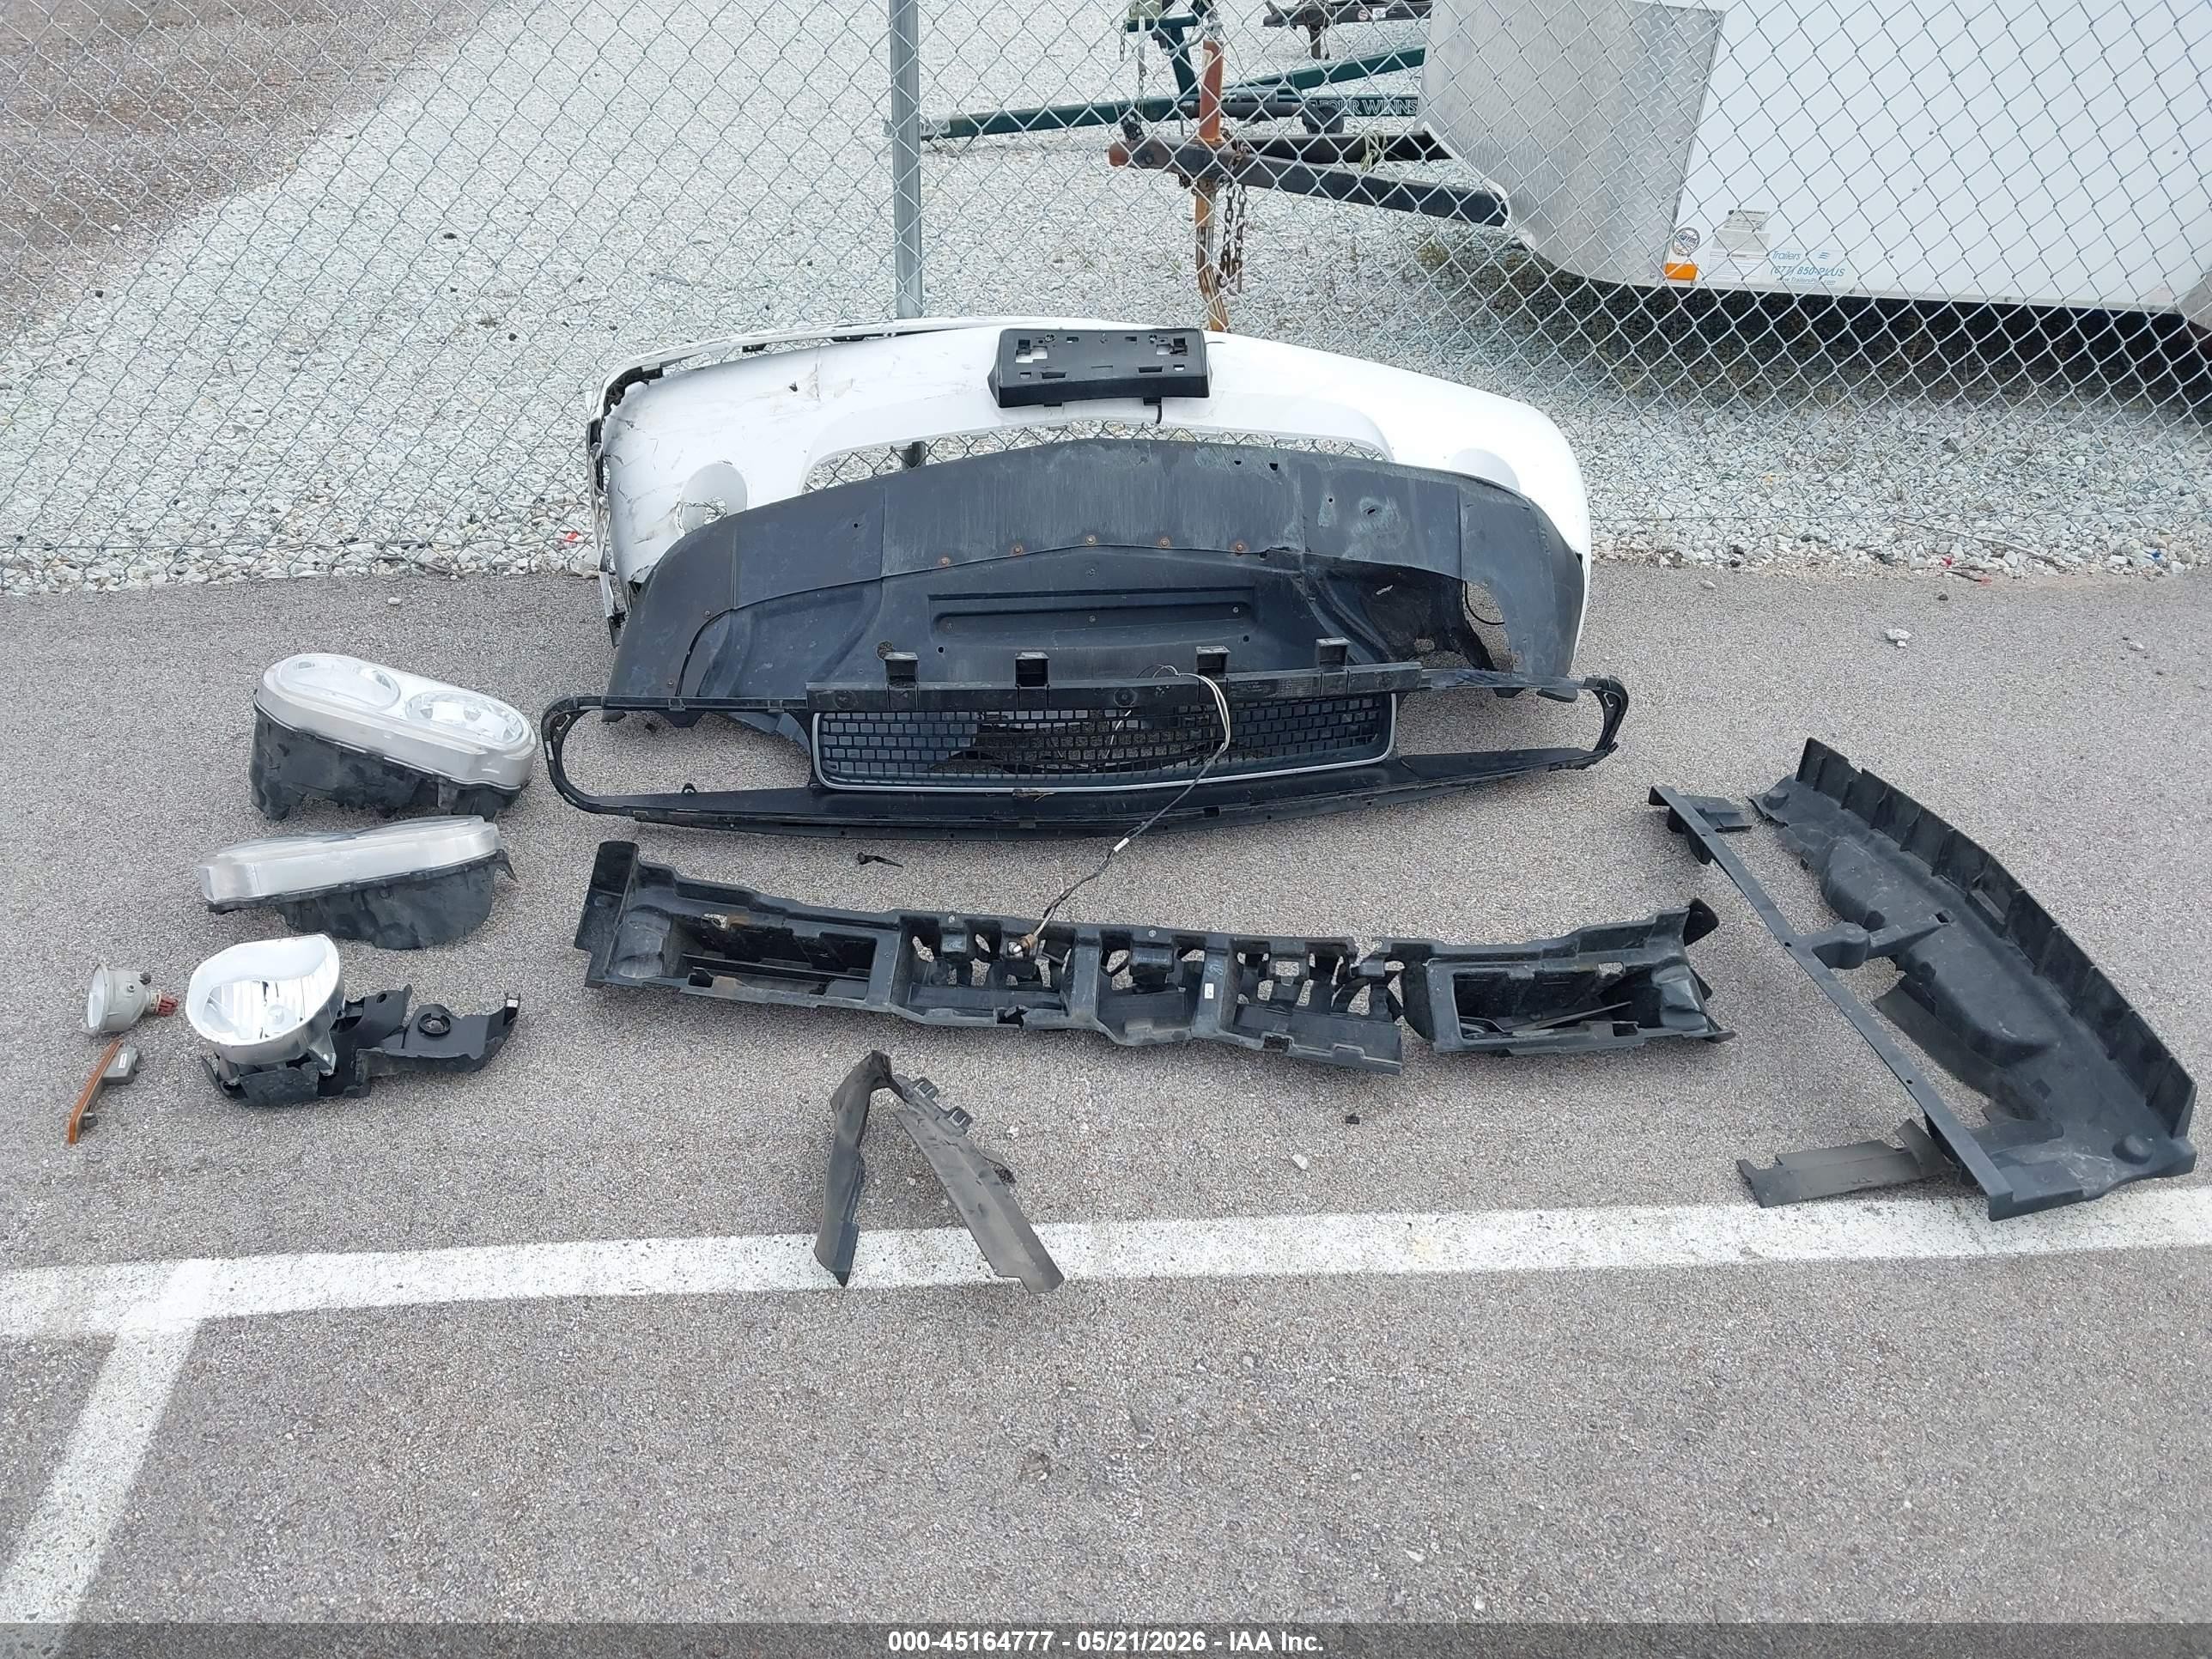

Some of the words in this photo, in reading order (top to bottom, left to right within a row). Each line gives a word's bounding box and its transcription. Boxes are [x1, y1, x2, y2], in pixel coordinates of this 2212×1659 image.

[1362, 100, 1417, 114] WINNS
[1772, 250, 1801, 260] Trailers
[1796, 266, 1845, 276] 850-PLUS
